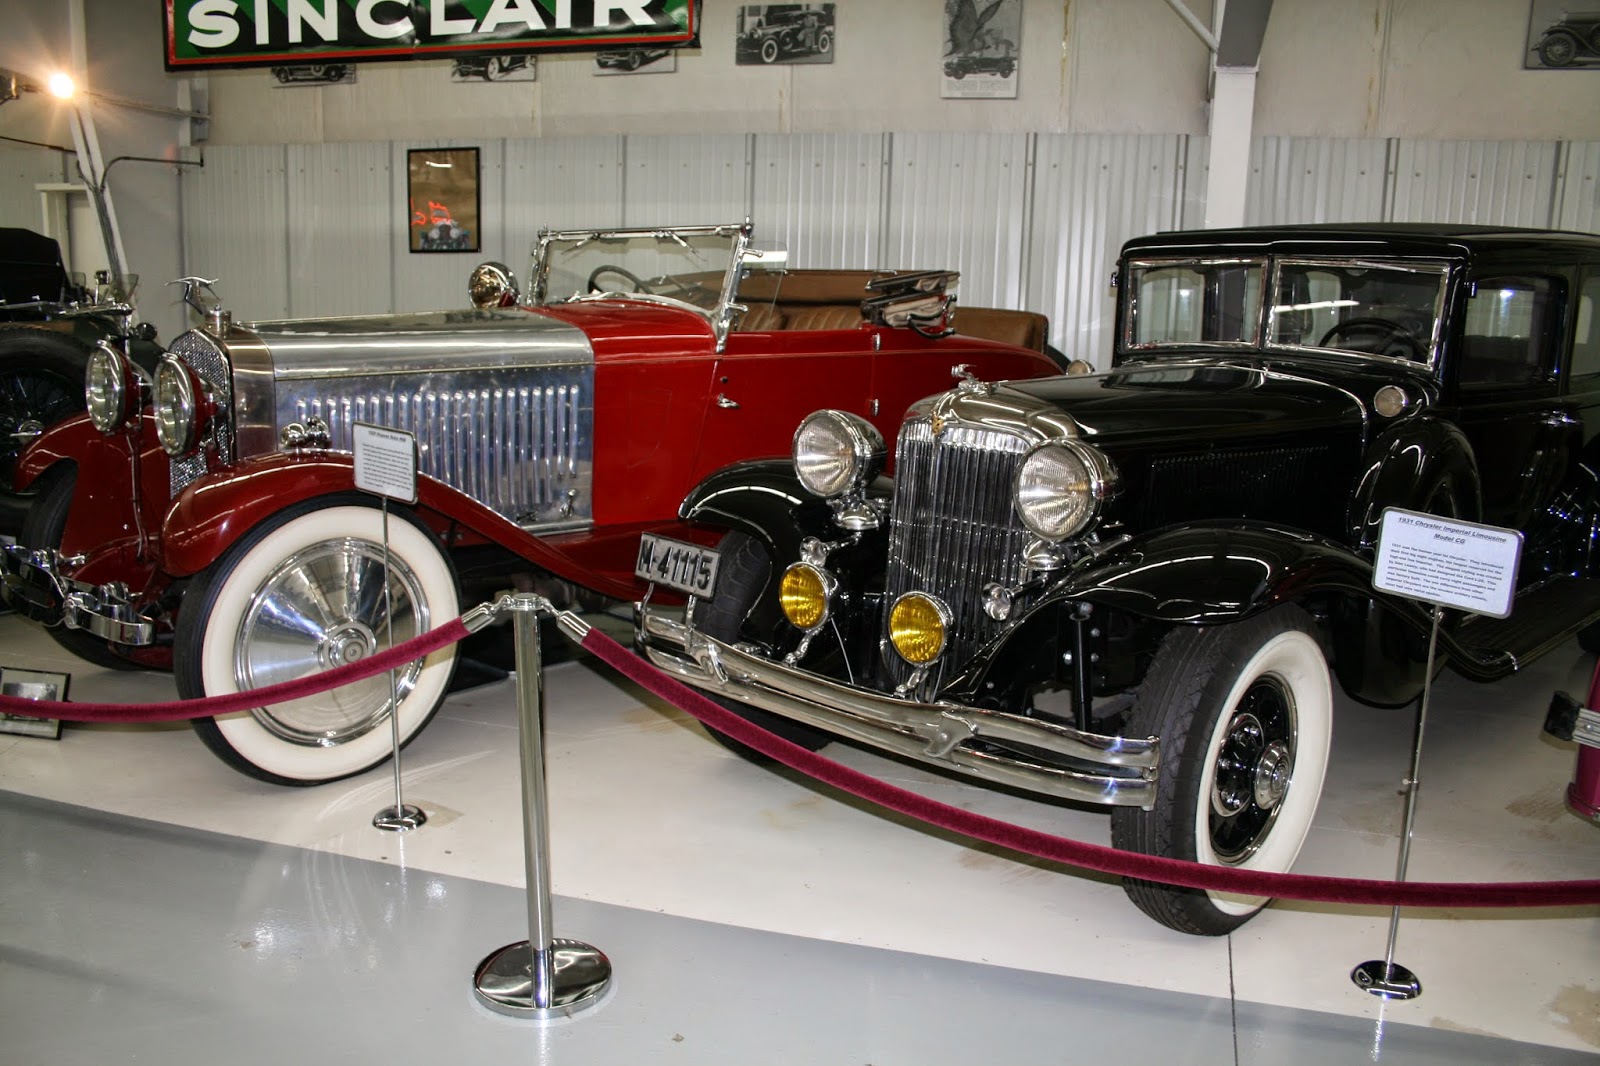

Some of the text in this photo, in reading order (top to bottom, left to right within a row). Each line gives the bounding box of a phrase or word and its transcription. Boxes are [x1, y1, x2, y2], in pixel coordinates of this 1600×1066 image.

[187, 0, 656, 48] SINCLAIR
[1398, 516, 1413, 524] 1931
[1414, 519, 1442, 530] Chrysler
[1442, 525, 1471, 536] Imperial
[1433, 532, 1454, 541] Model
